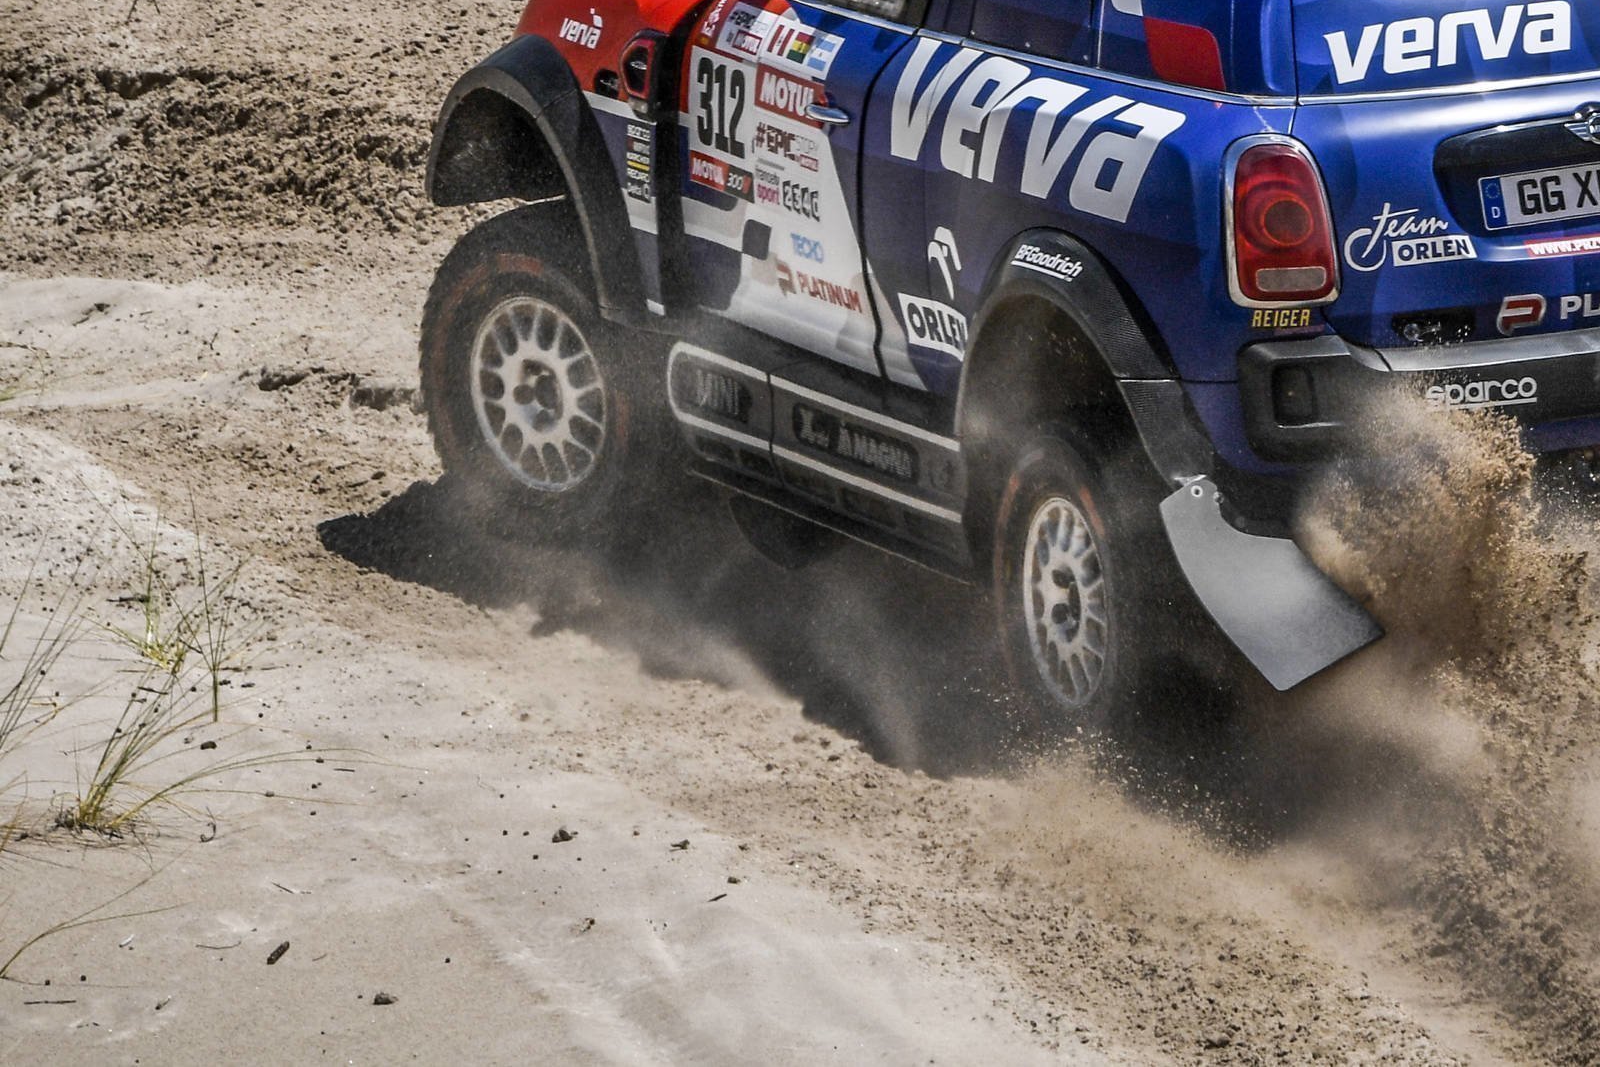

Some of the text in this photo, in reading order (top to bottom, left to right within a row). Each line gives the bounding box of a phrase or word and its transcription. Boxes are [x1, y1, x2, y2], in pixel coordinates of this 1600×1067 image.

[559, 16, 602, 49] verva
[1323, 0, 1571, 84] verva
[697, 57, 746, 159] 312
[890, 37, 1186, 223] verva
[692, 157, 726, 191] MOTUL
[1492, 206, 1500, 218] D
[1517, 175, 1566, 216] GG
[1344, 202, 1449, 271] team
[1398, 239, 1471, 261] ORLEN
[1015, 244, 1083, 277] BFGoodrich
[797, 270, 863, 313] PLATINUM
[1252, 309, 1311, 327] REIGER
[1426, 375, 1538, 405] sparco
